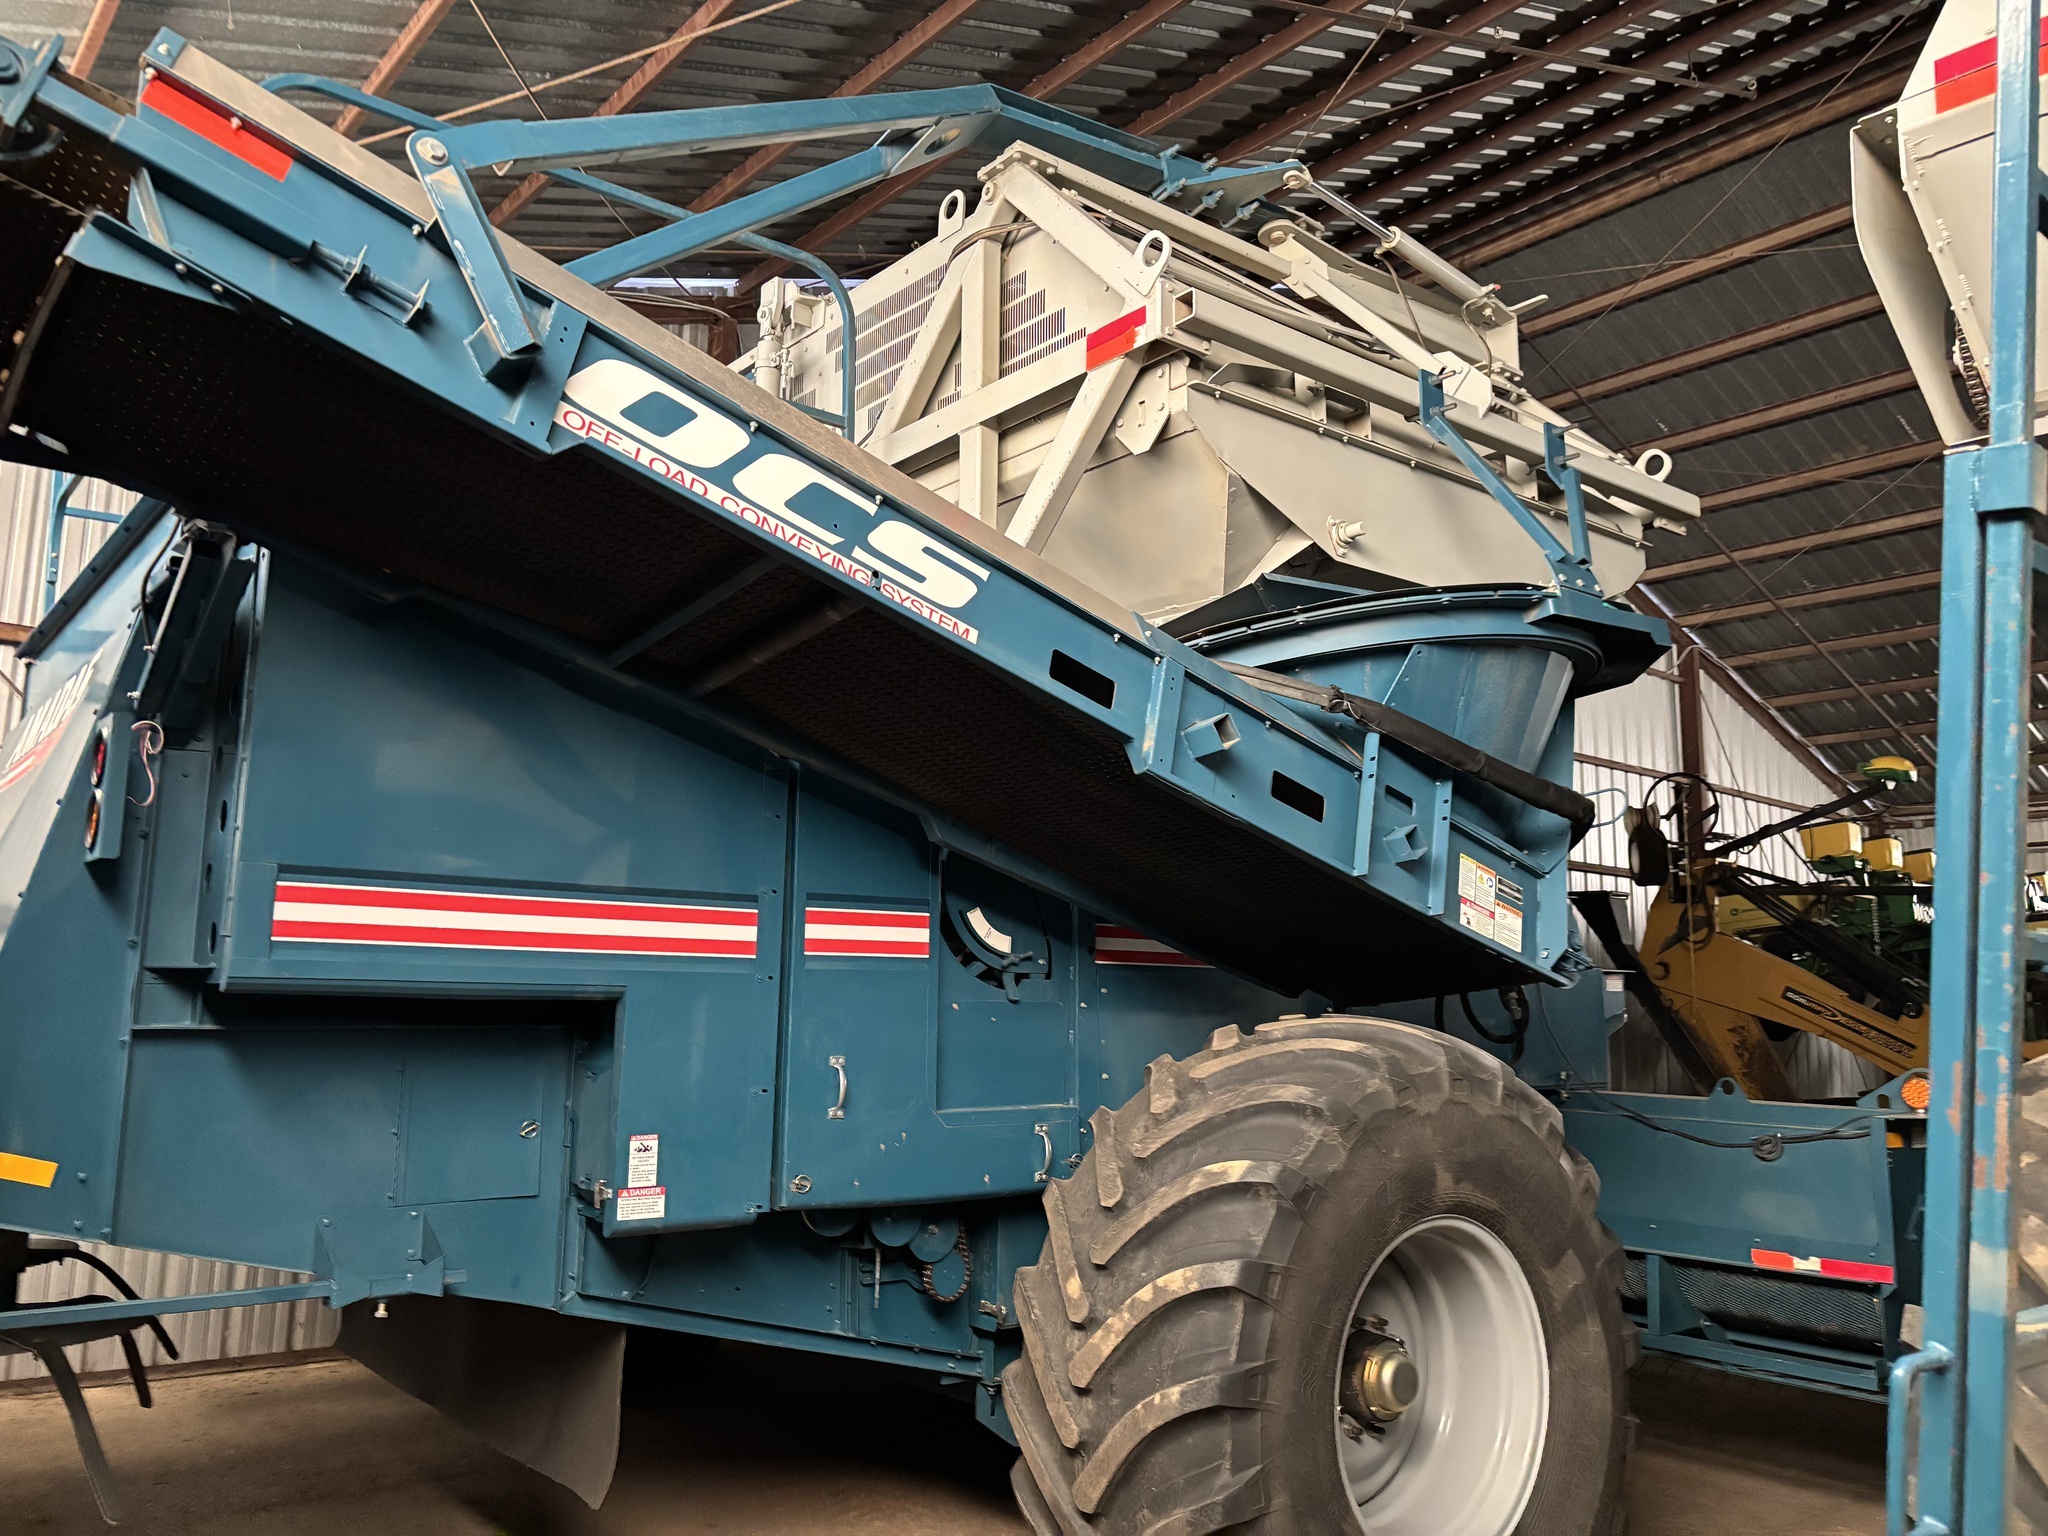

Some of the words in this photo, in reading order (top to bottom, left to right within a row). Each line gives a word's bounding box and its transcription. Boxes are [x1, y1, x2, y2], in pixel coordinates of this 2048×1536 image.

[563, 410, 708, 498] OFF-LOAD
[720, 496, 870, 586] CONVEYING
[880, 583, 970, 640] SYSTEM
[564, 358, 991, 609] OCS
[629, 1187, 661, 1197] DANGER
